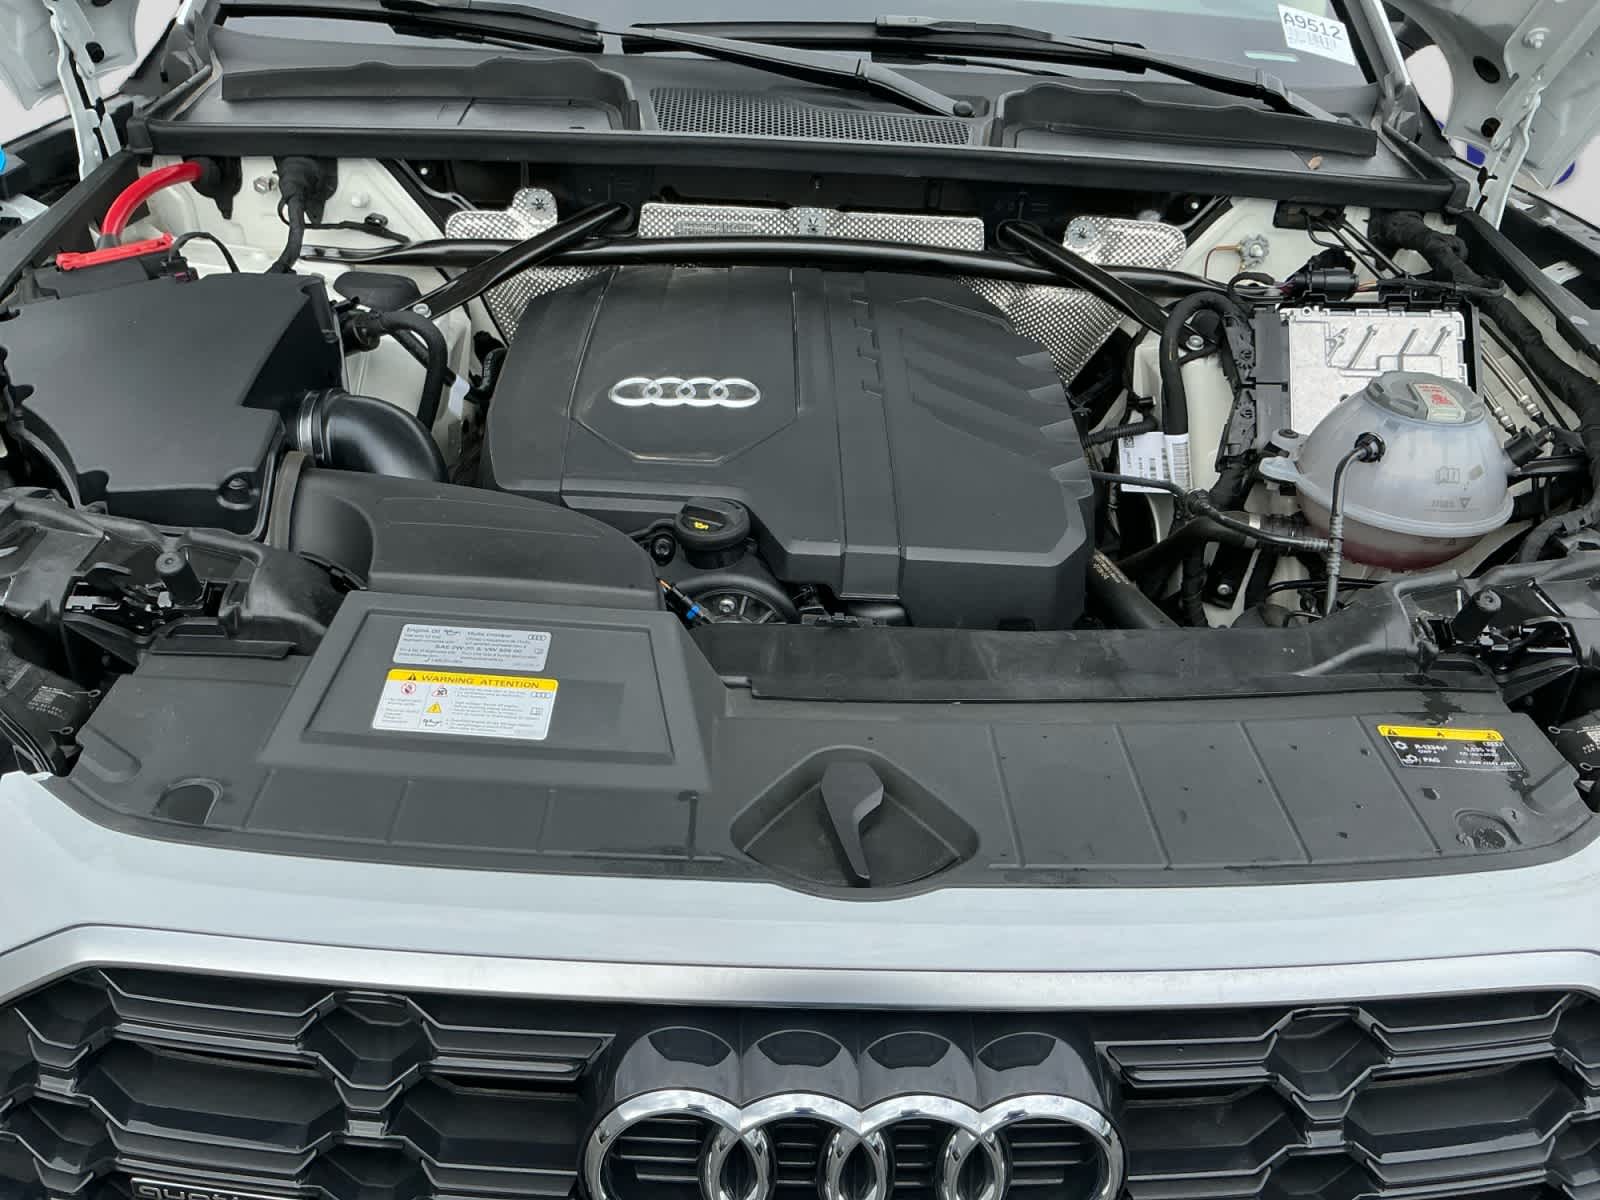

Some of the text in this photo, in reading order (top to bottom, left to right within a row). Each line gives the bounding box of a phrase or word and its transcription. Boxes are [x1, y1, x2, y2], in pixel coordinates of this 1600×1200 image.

[1283, 12, 1343, 40] A9512
[422, 674, 540, 689] WARNING ATTENTION
